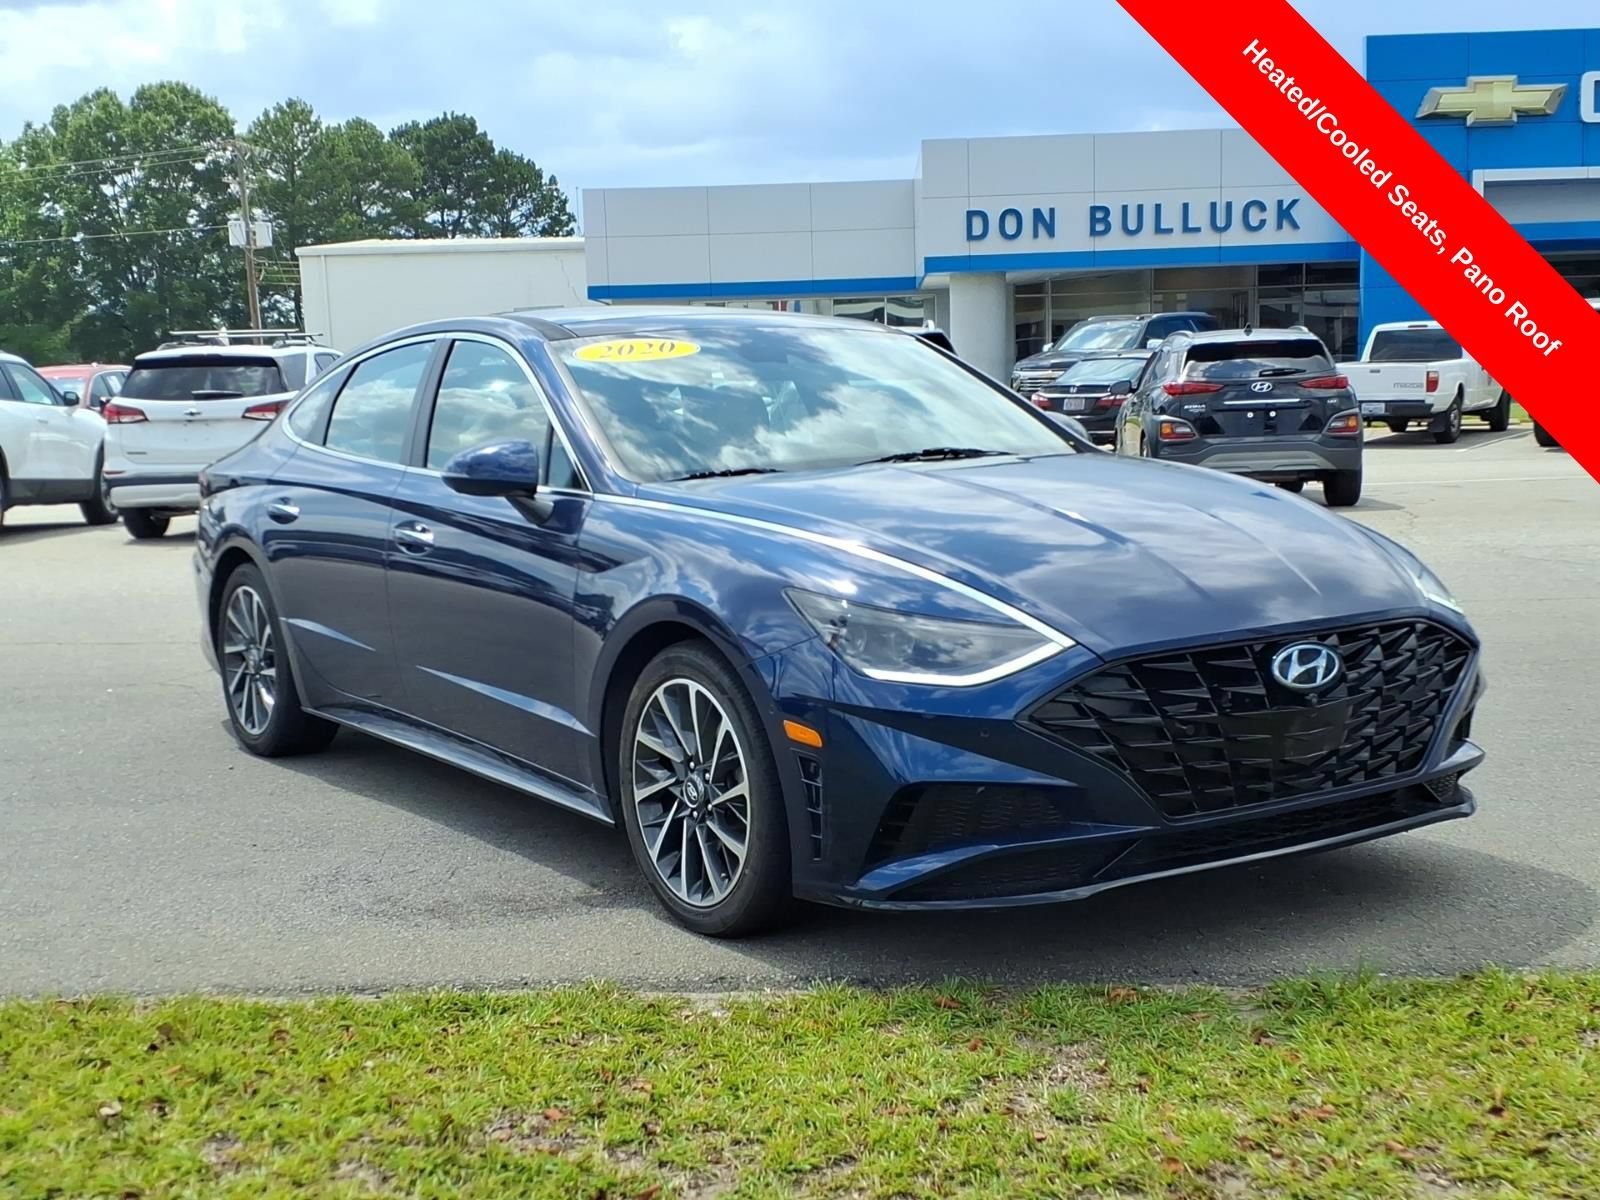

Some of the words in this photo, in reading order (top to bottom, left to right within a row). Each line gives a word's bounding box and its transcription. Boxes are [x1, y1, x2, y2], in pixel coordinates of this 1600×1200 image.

[965, 207, 1056, 241] DON
[1089, 198, 1301, 237] BULLUCK
[599, 341, 676, 358] 2020
